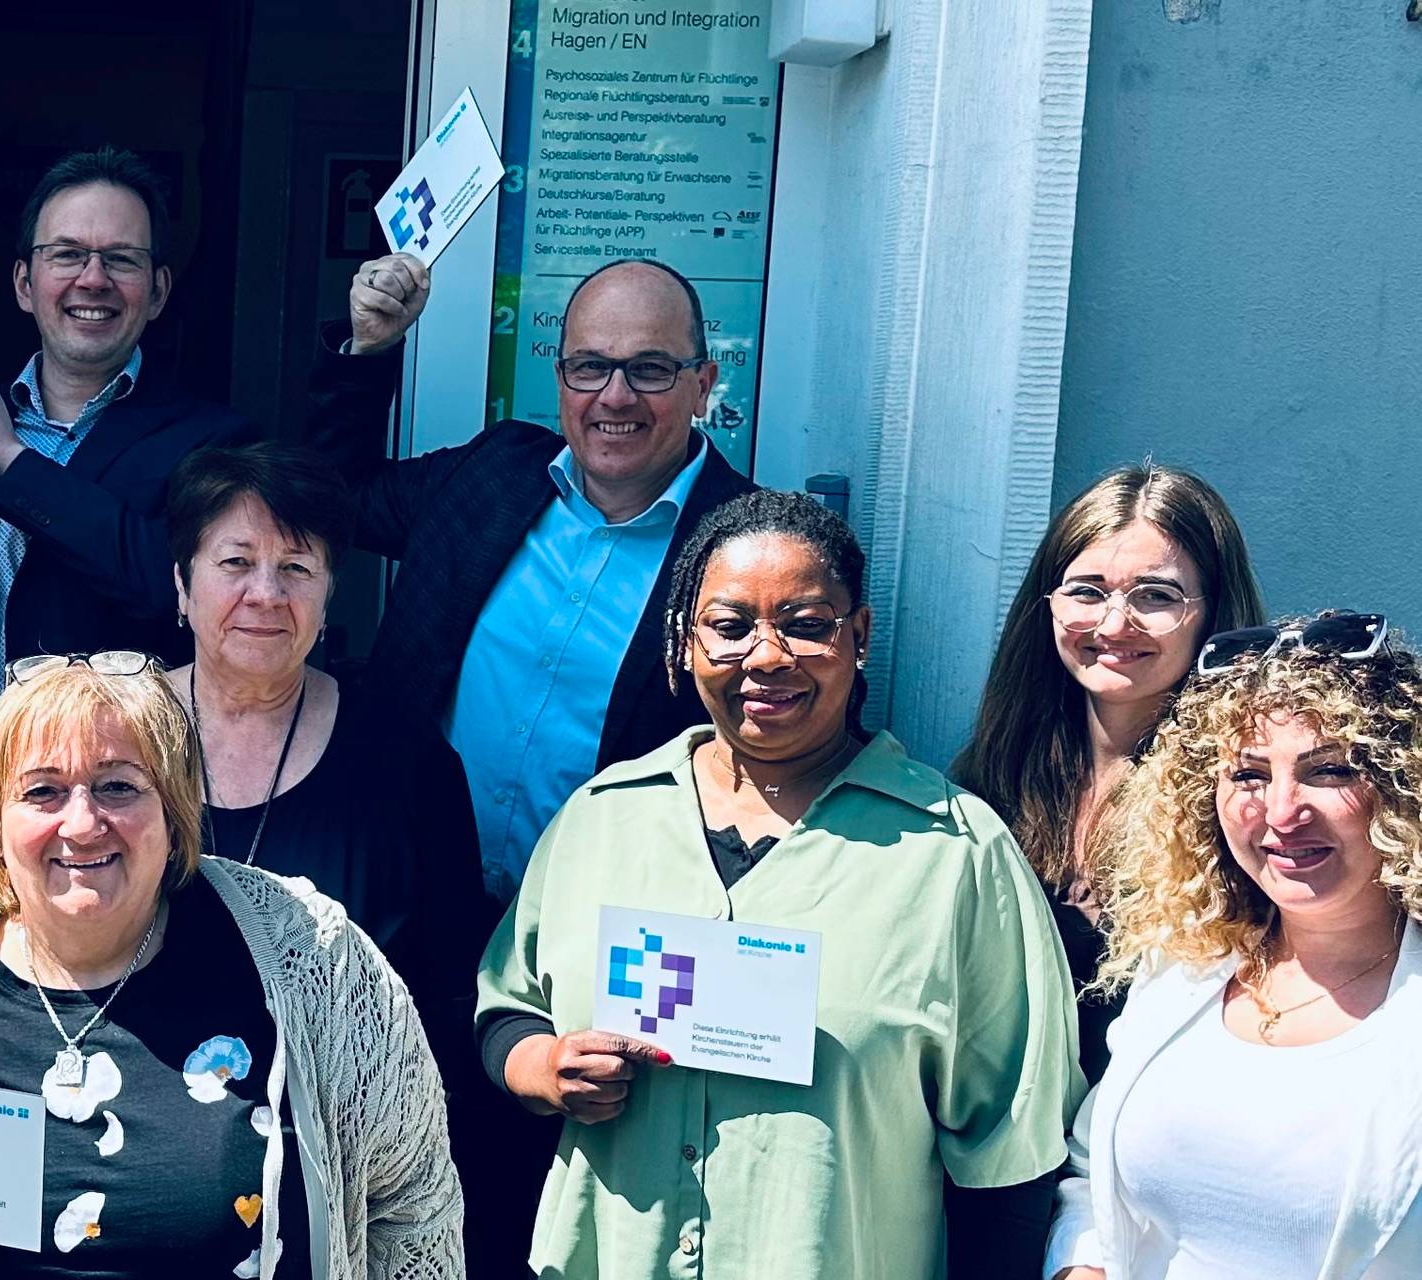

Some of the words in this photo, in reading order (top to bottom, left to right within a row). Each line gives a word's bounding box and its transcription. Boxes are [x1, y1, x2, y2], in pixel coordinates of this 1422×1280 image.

[552, 7, 629, 28] Migration
[634, 9, 666, 26] und
[671, 10, 760, 31] Integration
[513, 30, 533, 58] 4
[550, 31, 606, 51] Hagen
[609, 32, 619, 50] /
[622, 32, 647, 49] EN
[546, 69, 628, 83] Psychosoziales
[631, 71, 678, 83] Zentrum
[681, 72, 696, 84] für
[698, 72, 759, 88] Flüchtlinge
[544, 89, 599, 103] Regionale
[543, 109, 594, 121] Ausreise-
[597, 111, 618, 121] und
[621, 110, 726, 127] Perspektivberatung
[541, 130, 647, 144] Integrationsagentur
[540, 148, 612, 161] Spezialisierte
[614, 150, 699, 165] Beratungsstelle
[503, 164, 525, 193] 3
[539, 169, 645, 184] Migrationsberatung
[647, 171, 662, 182] für
[664, 171, 732, 183] Erwachsene
[538, 188, 666, 204] Deutschkurse/Beratung
[536, 207, 571, 219] Arbeit-
[574, 208, 632, 220] Potentiale-
[635, 210, 705, 223] Perspektiven
[535, 224, 550, 235] für
[552, 224, 612, 239] Flüchtlinge
[614, 226, 645, 240] (APP)
[534, 243, 602, 255] Servicestelle
[604, 245, 657, 257] Ehrenamt
[493, 305, 515, 334] 2
[738, 935, 792, 952] Diakonie
[692, 1022, 714, 1033] Diese
[715, 1026, 758, 1041] Einrichtung
[691, 1044, 746, 1059] Evangelischen
[746, 1052, 772, 1064] Kirche
